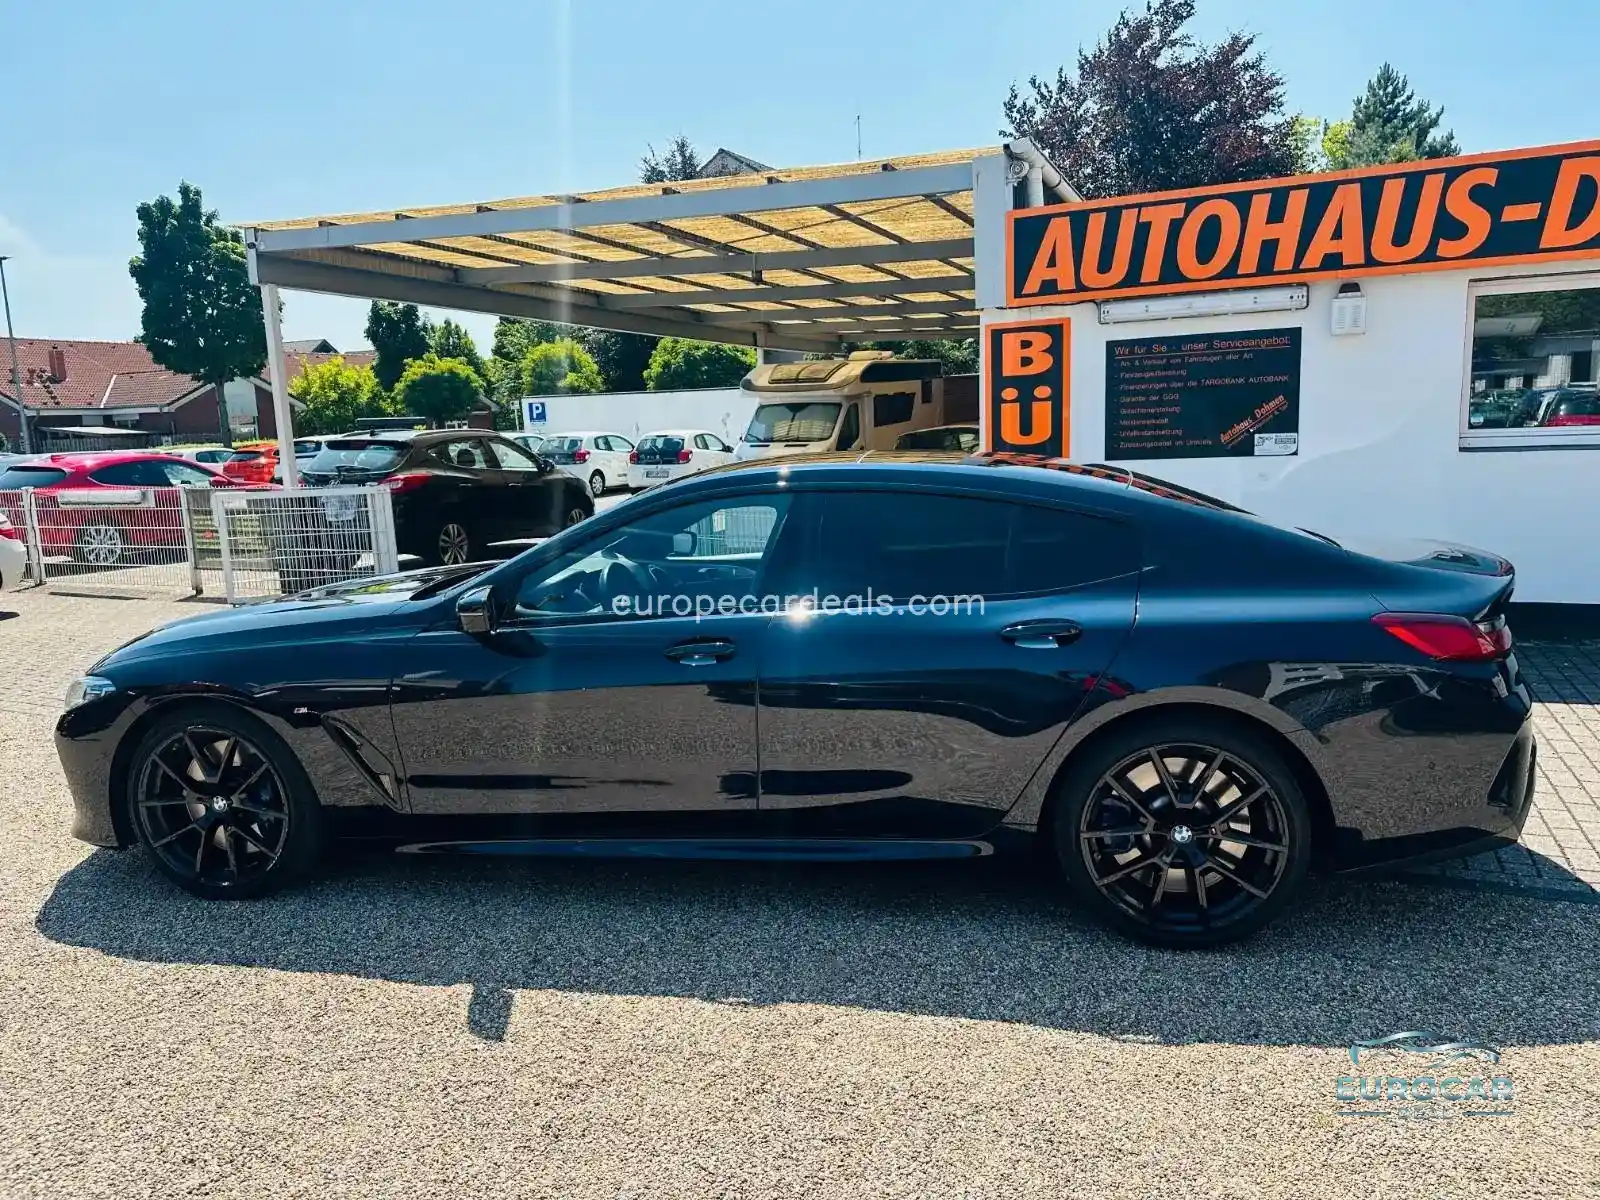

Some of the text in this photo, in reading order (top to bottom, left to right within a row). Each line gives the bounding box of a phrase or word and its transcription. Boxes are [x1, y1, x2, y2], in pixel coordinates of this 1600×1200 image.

[1021, 156, 1600, 295] AUTOHAUS-D
[1152, 343, 1167, 353] Sie
[1181, 342, 1208, 351] unser
[1213, 336, 1291, 349] Serviceangebot:
[1249, 375, 1289, 383] AUTOBANK
[532, 403, 543, 419] P
